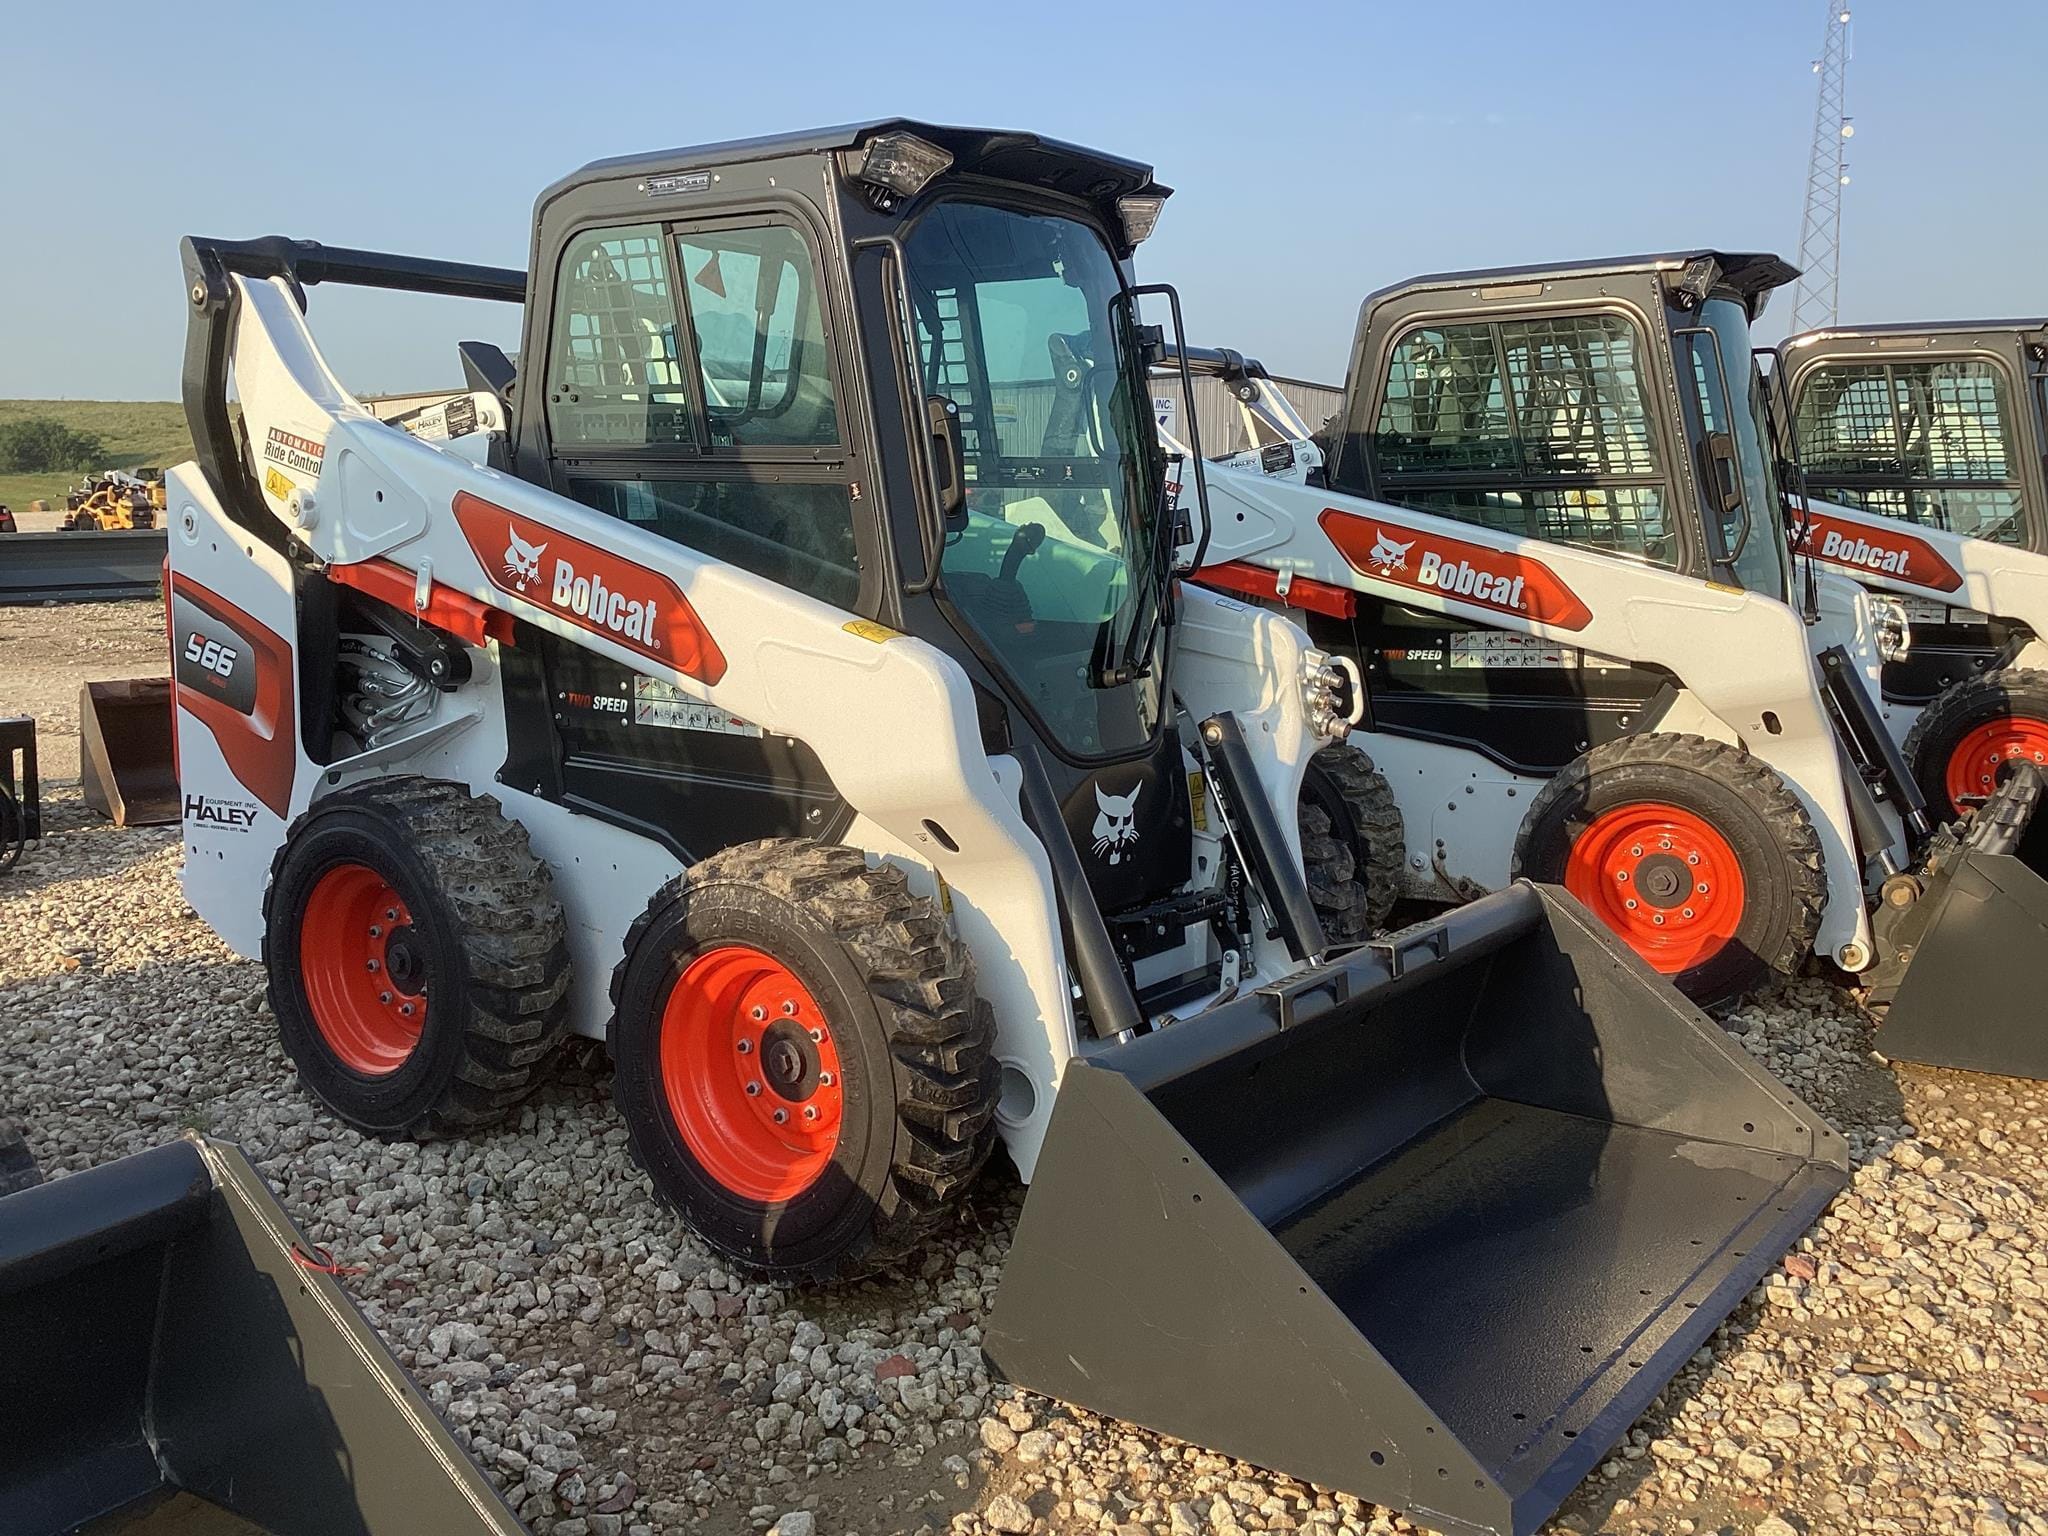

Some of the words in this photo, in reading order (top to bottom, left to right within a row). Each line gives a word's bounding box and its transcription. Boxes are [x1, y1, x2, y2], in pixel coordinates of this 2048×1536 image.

[1155, 399, 1172, 409] INC.
[264, 441, 286, 462] Ride
[287, 449, 323, 476] Control
[269, 428, 324, 457] AUTOMATIC
[1821, 530, 1909, 575] Bobcat
[1417, 551, 1525, 609] Bobcat
[551, 558, 657, 647] Bobcat
[184, 632, 237, 677] S66
[1383, 650, 1405, 661] TWO
[1406, 649, 1443, 661] SPEED
[568, 692, 592, 707] TWO
[593, 695, 628, 713] SPEED
[184, 794, 258, 826] HALEY
[205, 798, 242, 808] EQUIPMENT
